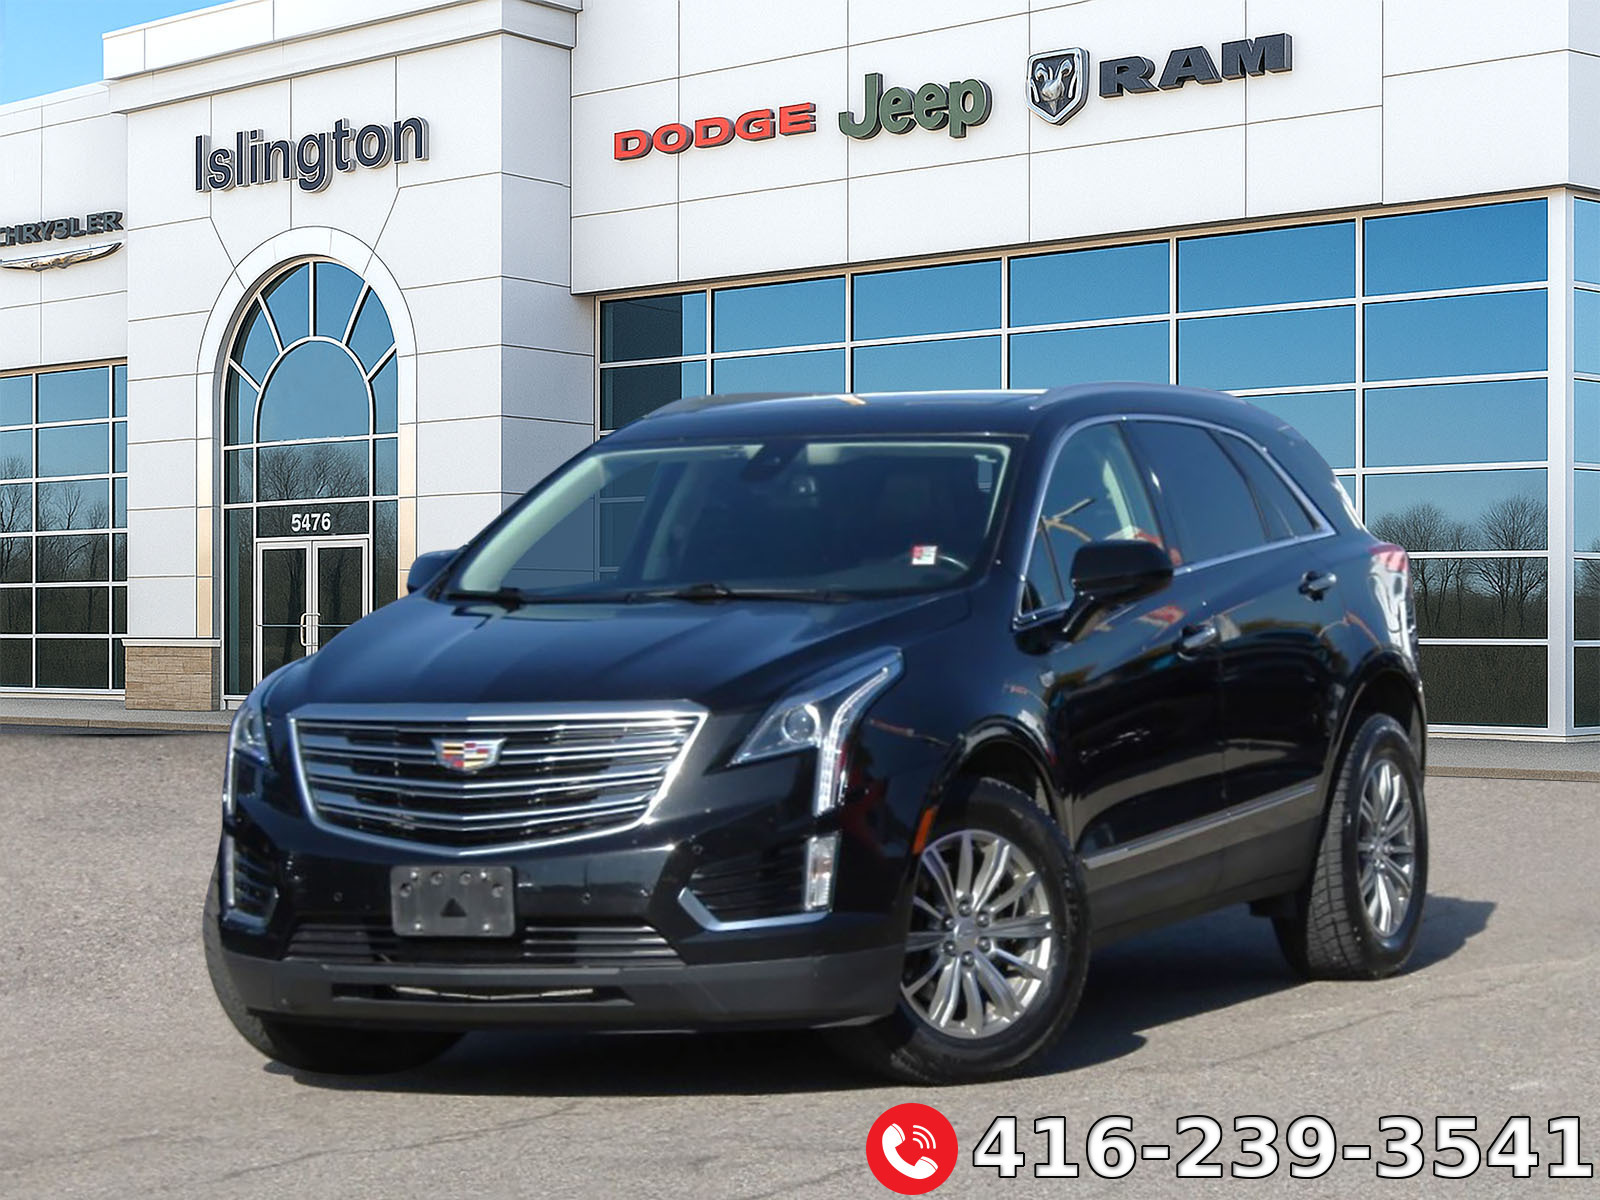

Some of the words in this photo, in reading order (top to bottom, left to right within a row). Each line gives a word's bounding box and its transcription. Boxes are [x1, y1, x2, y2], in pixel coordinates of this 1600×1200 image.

[1099, 33, 1293, 98] RAM
[613, 102, 817, 161] DODGE
[838, 72, 992, 139] Jeep
[194, 115, 430, 193] Islington
[291, 512, 331, 532] 5476
